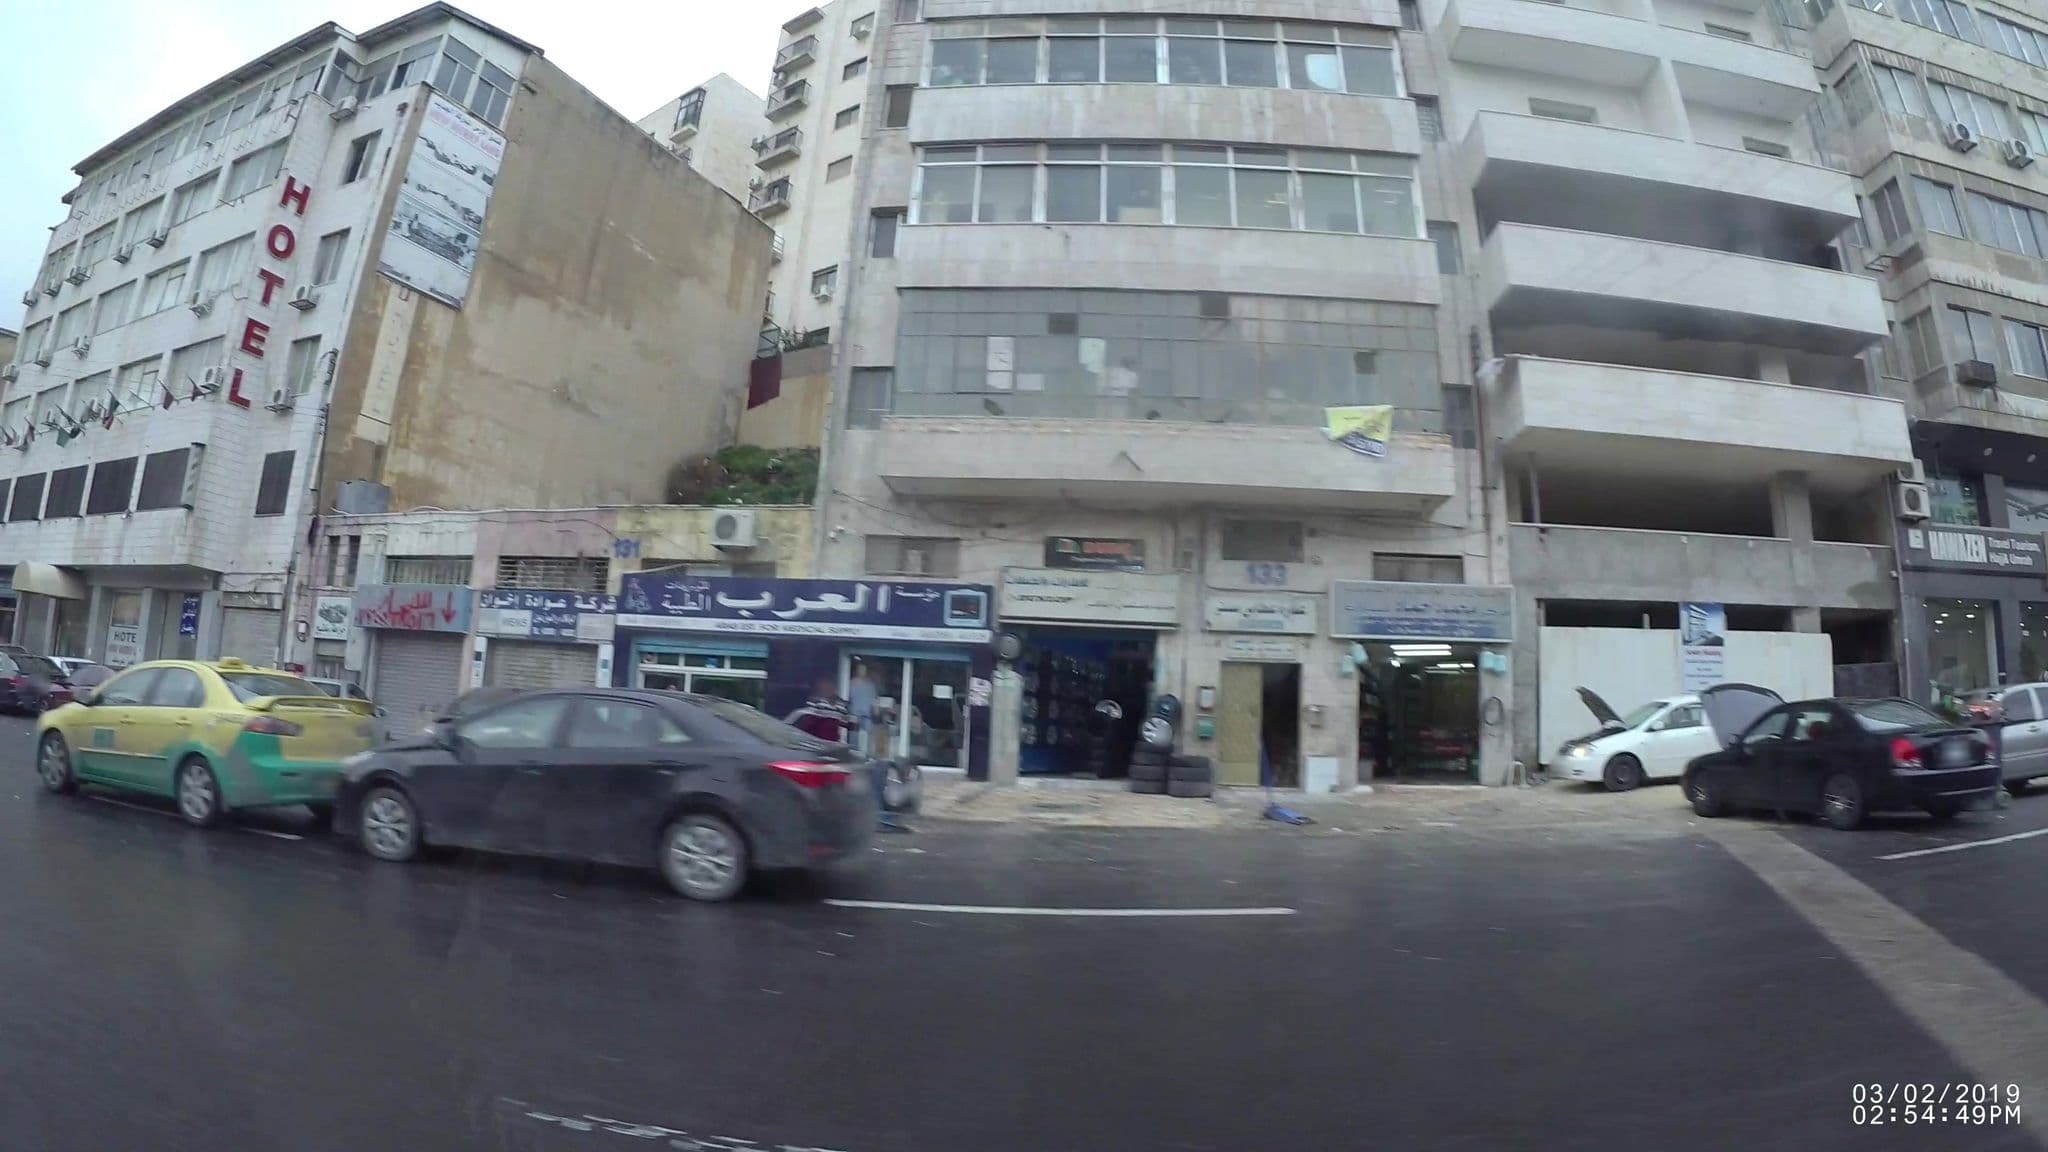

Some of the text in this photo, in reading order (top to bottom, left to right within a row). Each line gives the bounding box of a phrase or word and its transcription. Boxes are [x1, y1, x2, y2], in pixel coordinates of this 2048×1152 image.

[228, 175, 311, 408] HOTEL
[1246, 563, 1288, 586] 133
[573, 594, 618, 614] شركة
[716, 581, 893, 620] العرب
